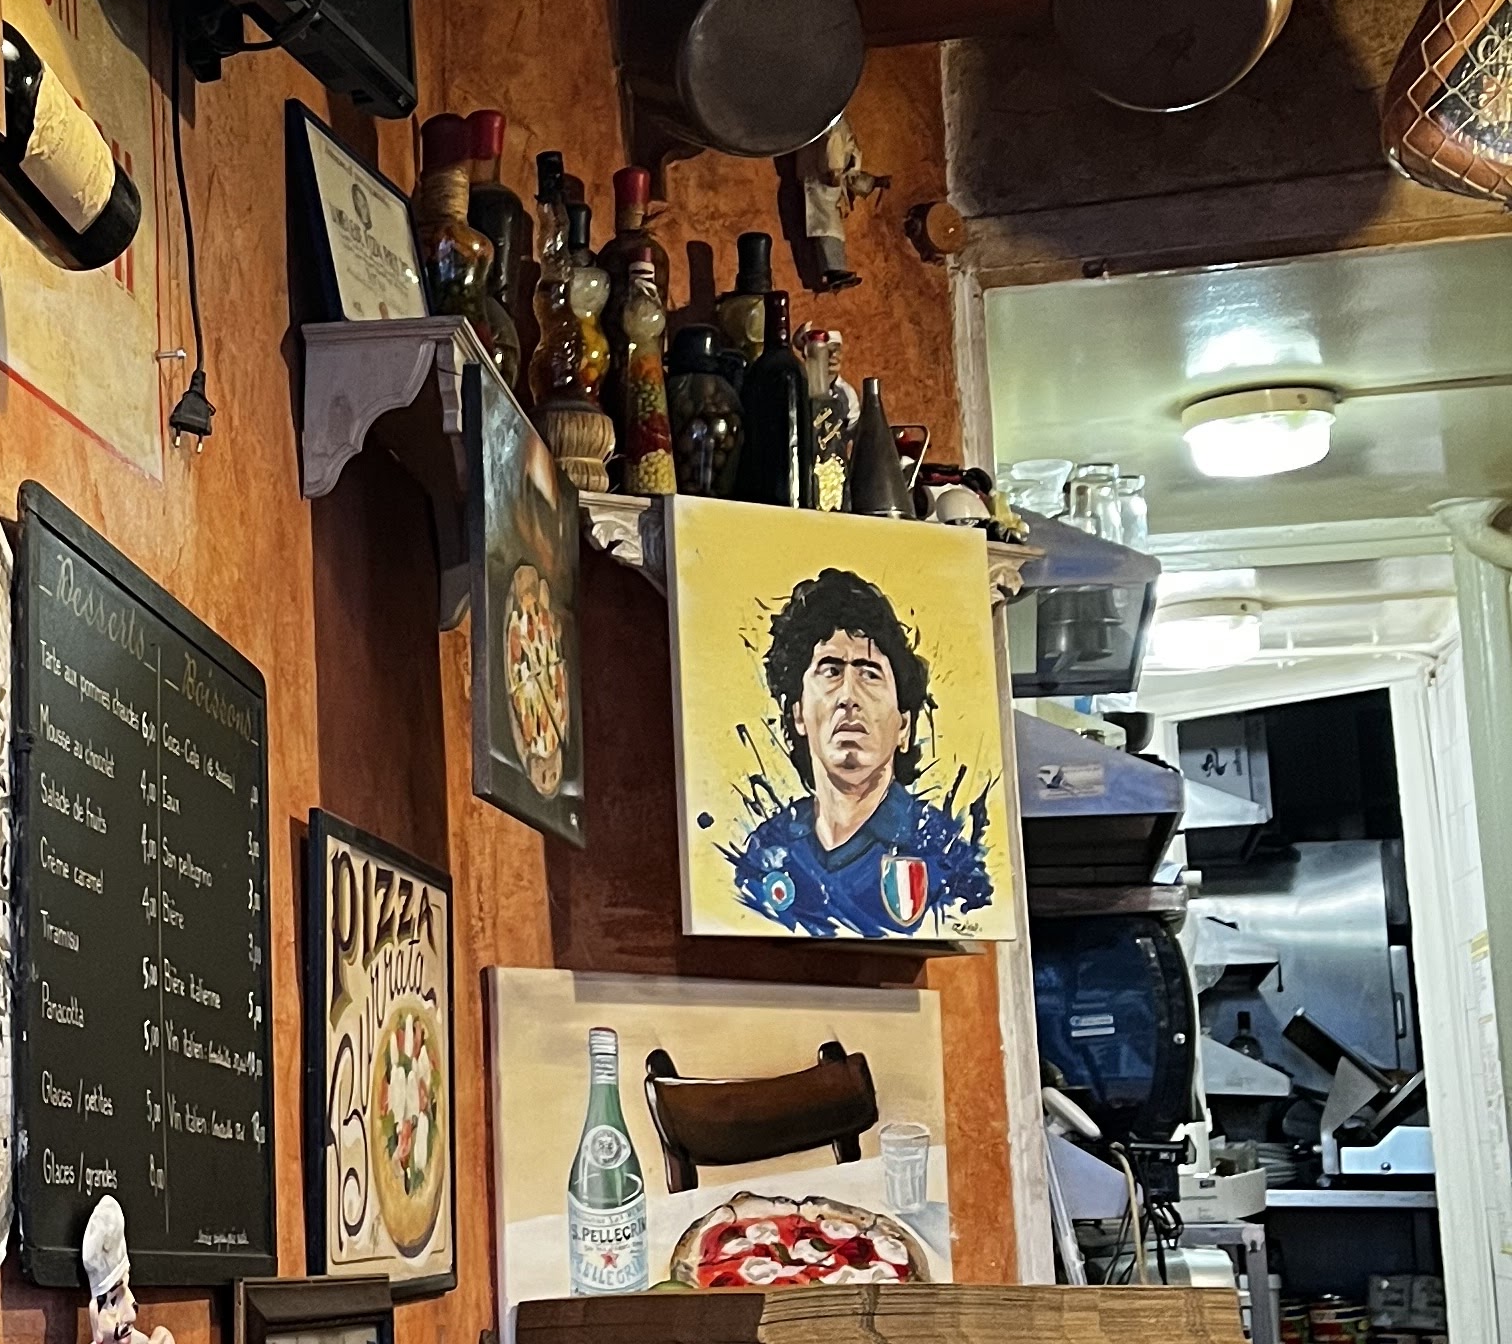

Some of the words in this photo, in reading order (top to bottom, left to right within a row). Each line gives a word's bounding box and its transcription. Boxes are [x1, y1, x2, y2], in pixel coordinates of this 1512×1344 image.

[56, 554, 145, 660] Desserts
[181, 651, 252, 741] Boissons
[39, 703, 71, 753] Mousse
[40, 771, 71, 816] Salade
[40, 835, 70, 879] Crème
[39, 908, 80, 953] Tiramisu
[329, 848, 440, 1032] PIZZA
[41, 980, 85, 1029] Panacotta
[41, 1069, 73, 1109] Glaces
[42, 1147, 76, 1185] Glaces
[85, 1157, 118, 1197] grandes
